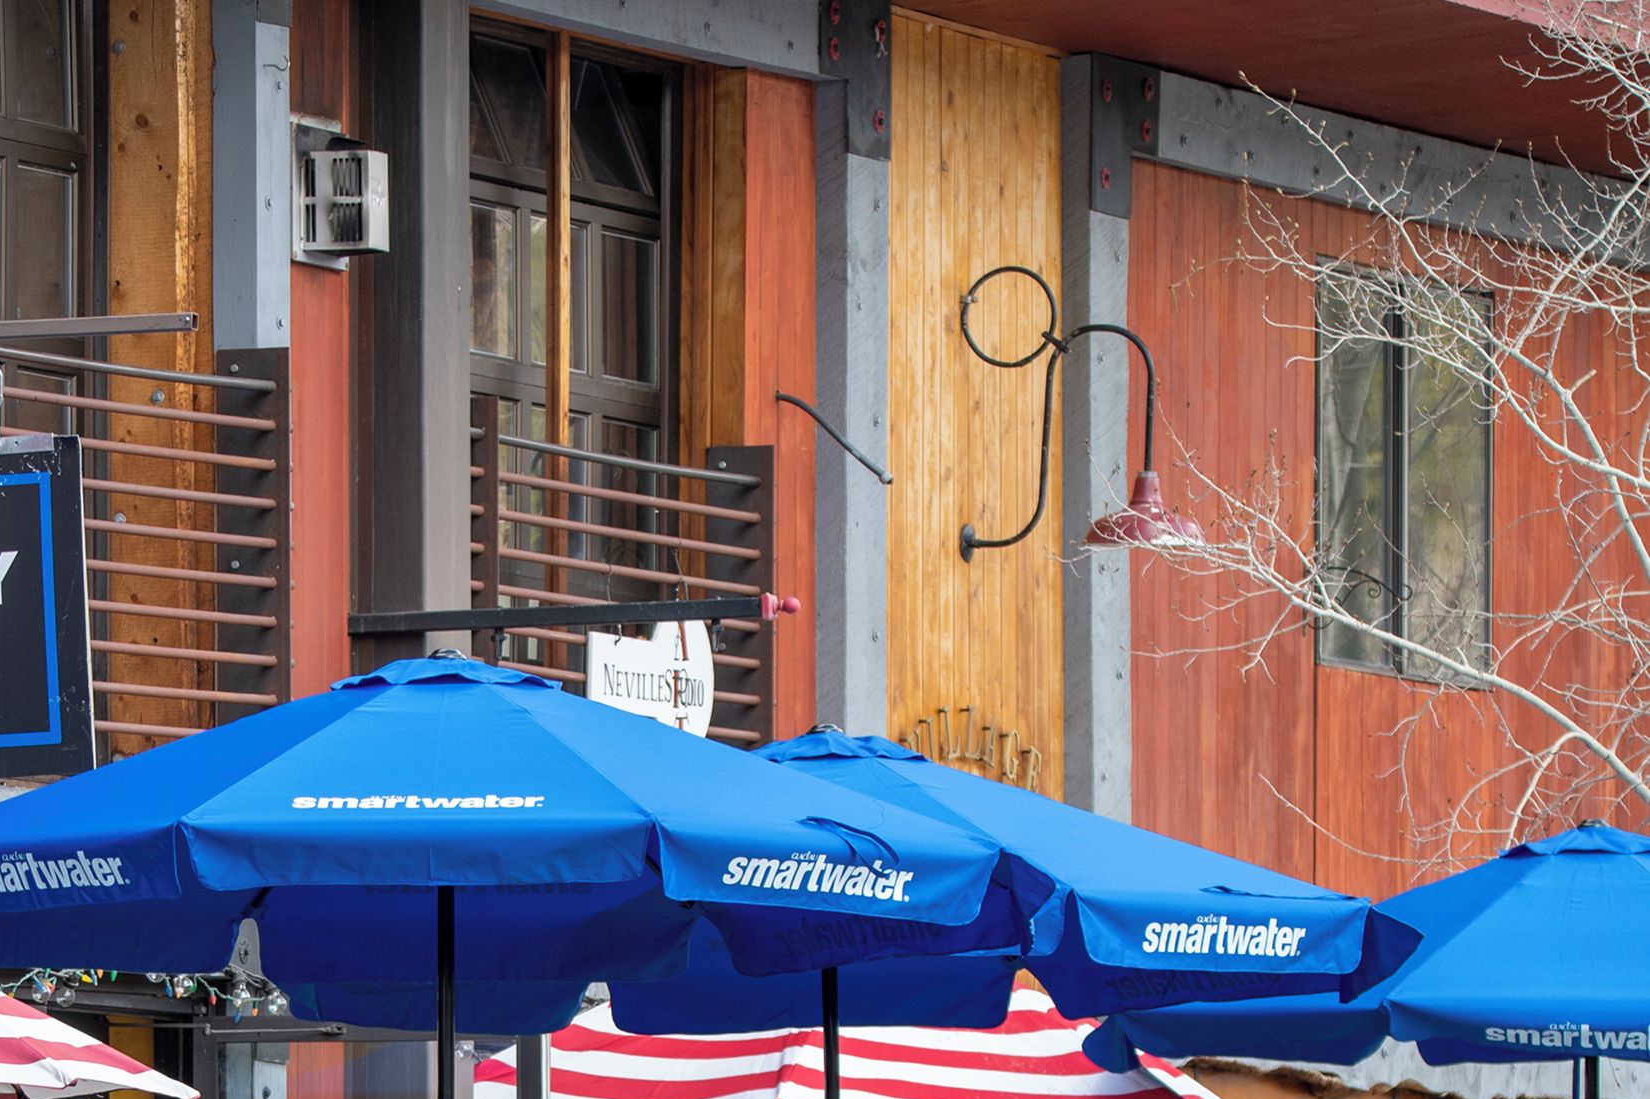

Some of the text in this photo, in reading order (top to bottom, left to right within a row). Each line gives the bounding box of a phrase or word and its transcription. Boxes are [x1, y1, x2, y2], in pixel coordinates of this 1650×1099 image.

[291, 794, 544, 809] smartwater
[722, 854, 914, 902] smartwater
[1142, 916, 1306, 957] smartwater
[1485, 1024, 1650, 1050] smartwa
